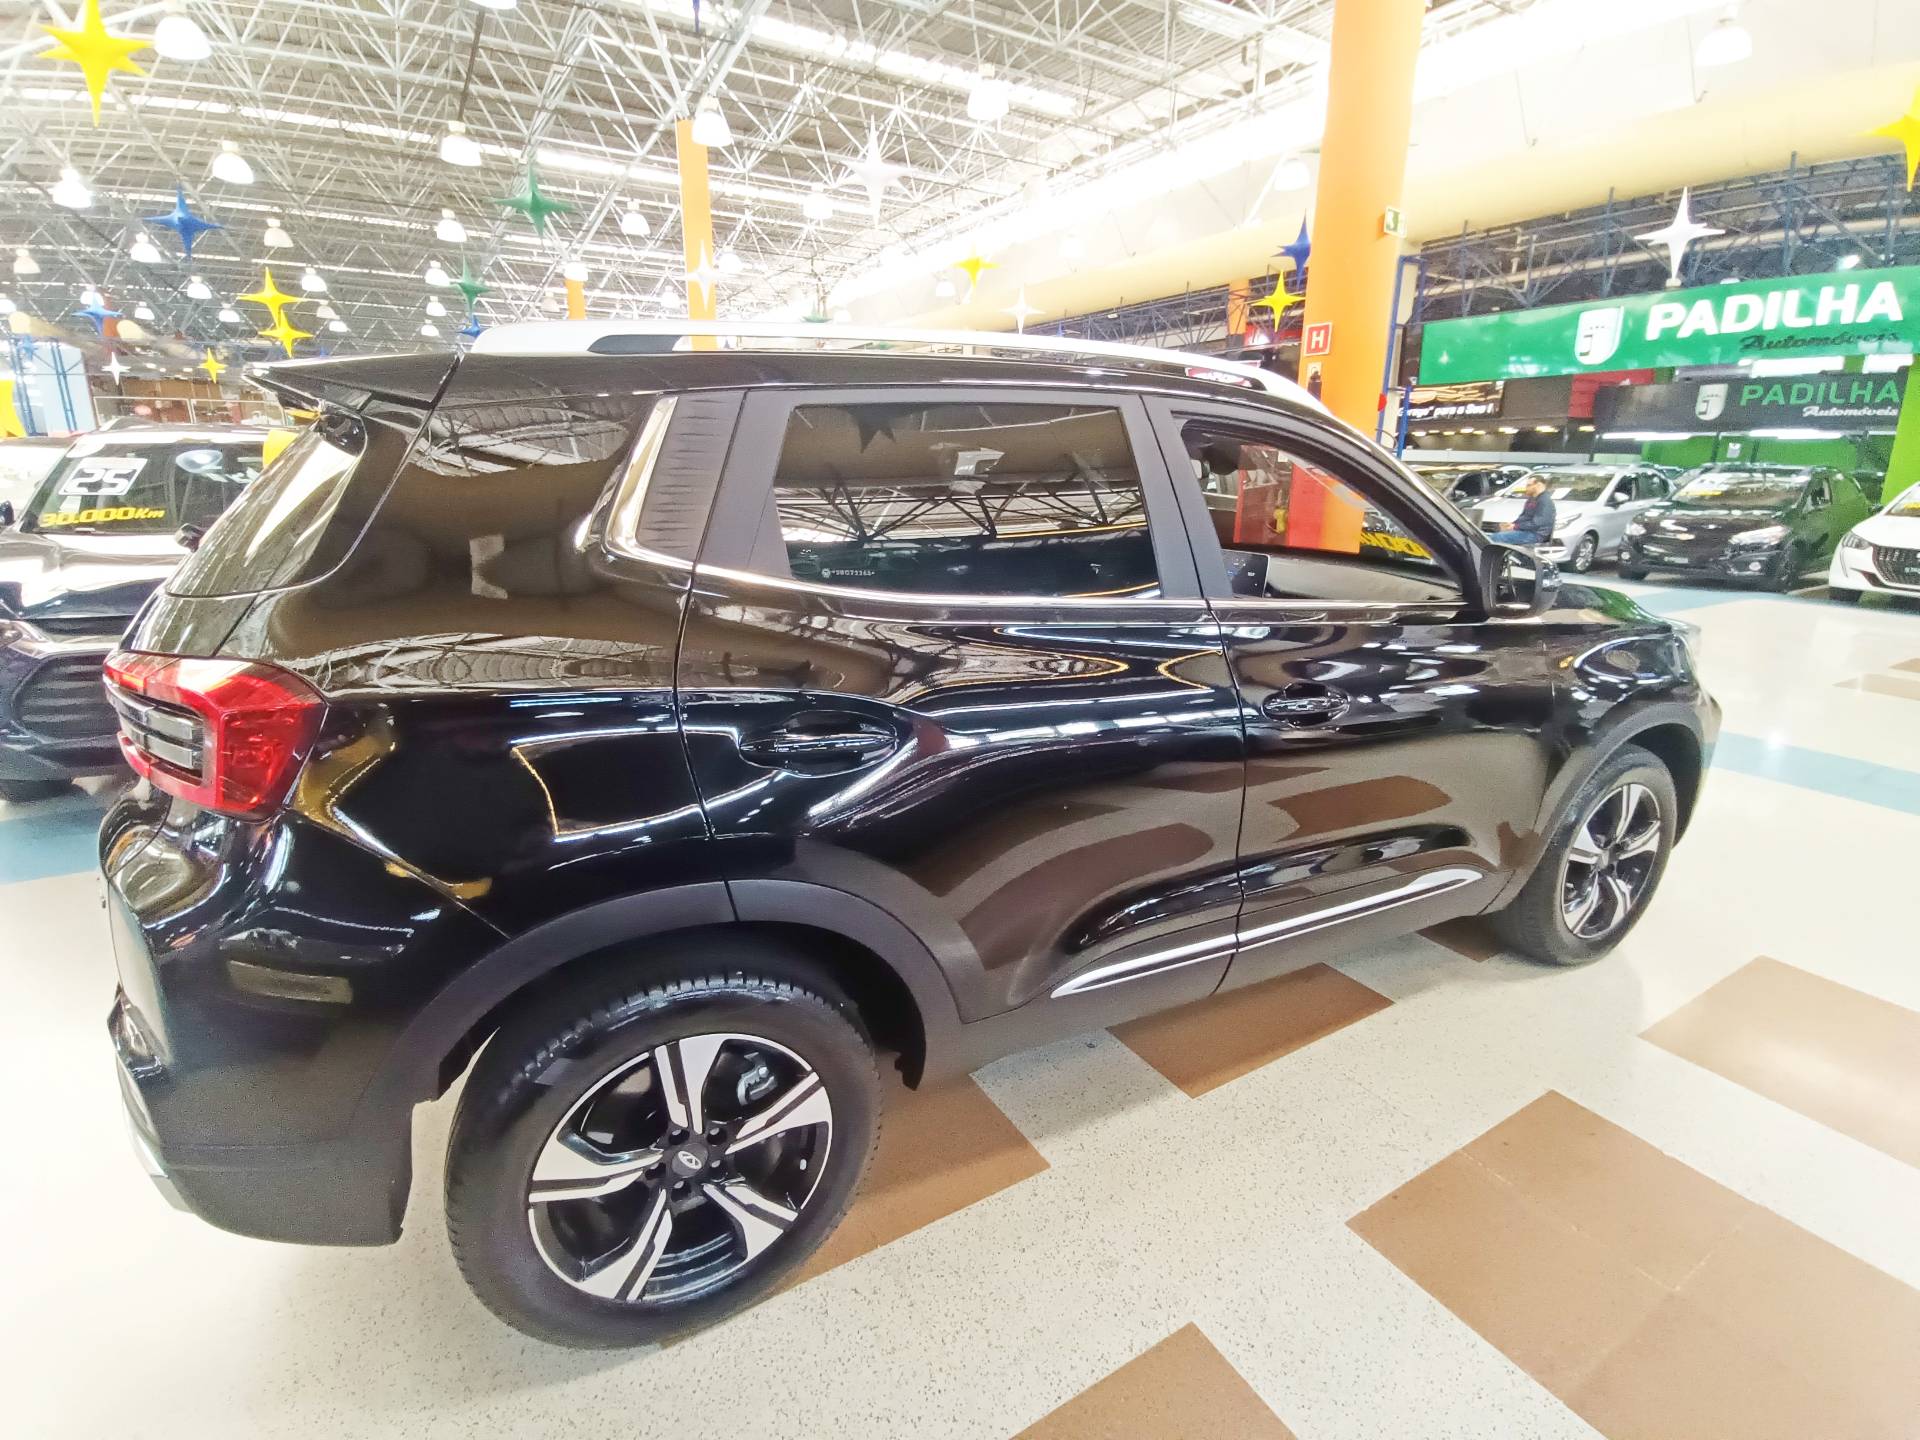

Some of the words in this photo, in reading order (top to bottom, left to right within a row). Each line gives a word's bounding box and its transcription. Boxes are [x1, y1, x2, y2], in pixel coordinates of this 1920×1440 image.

[1645, 281, 1903, 341] PADILHA
[1311, 329, 1325, 349] H
[1739, 379, 1900, 406] PADILHA
[1802, 405, 1899, 417] Automóveis
[65, 467, 138, 494] 25
